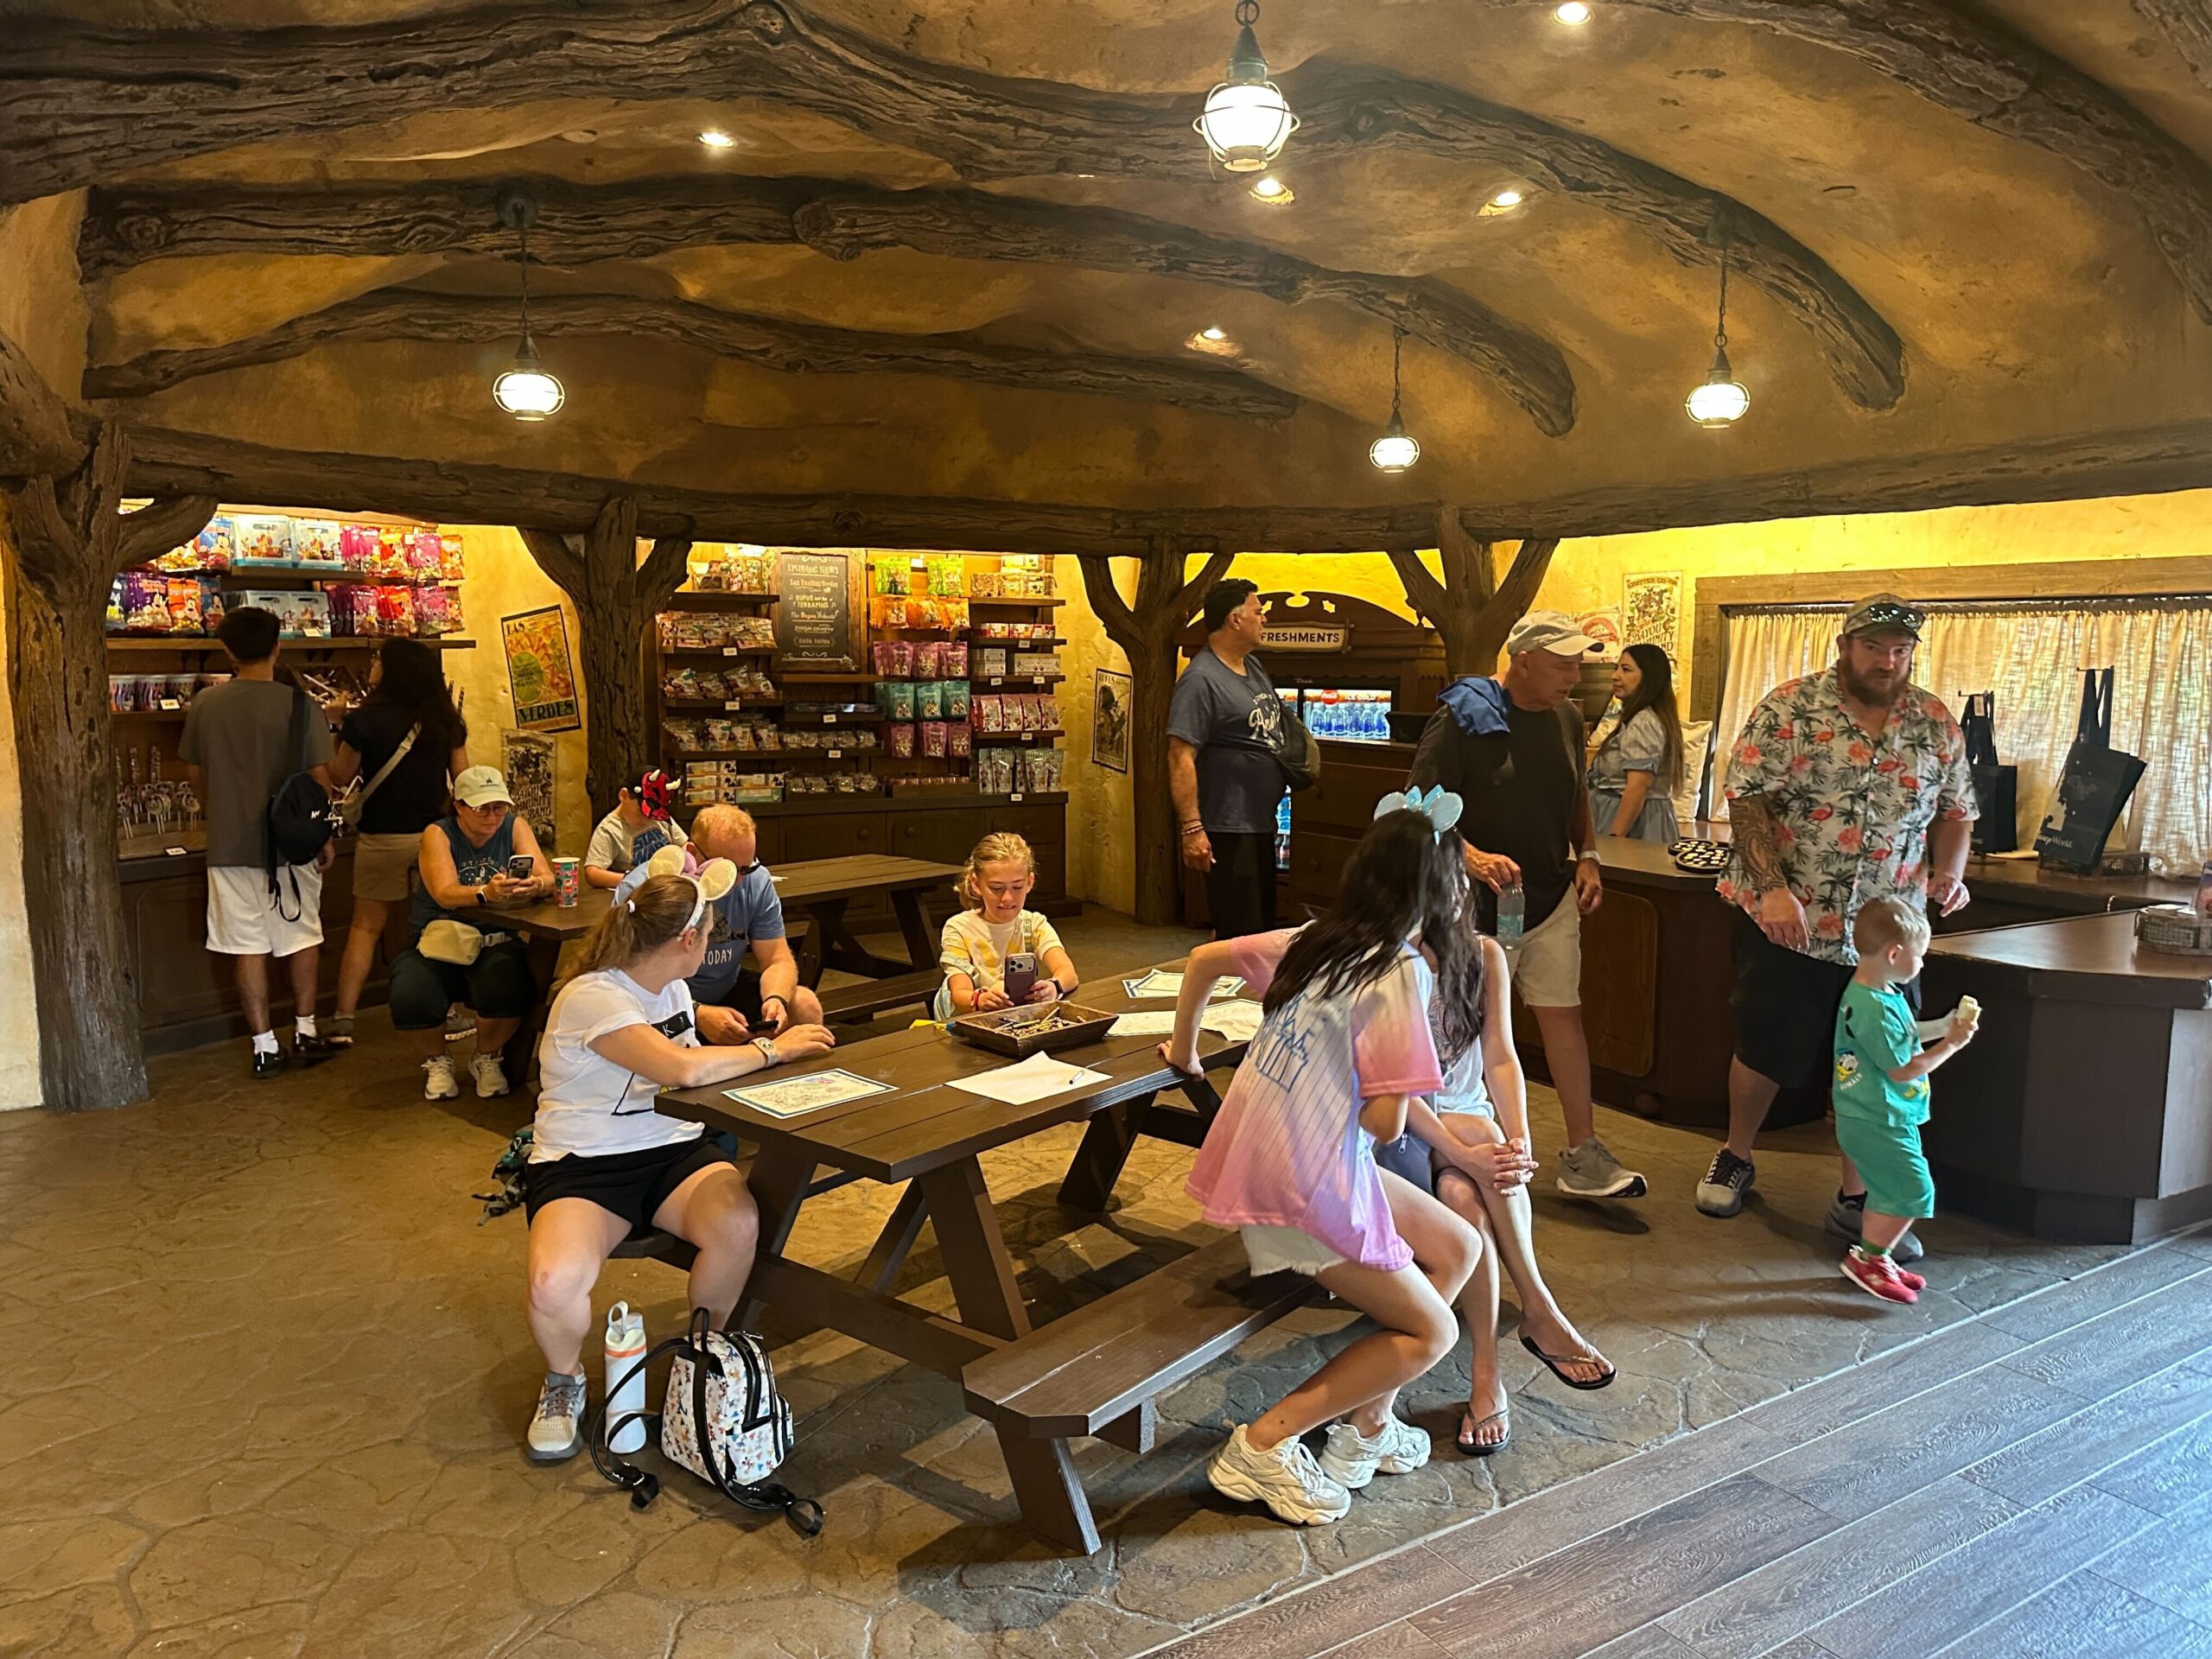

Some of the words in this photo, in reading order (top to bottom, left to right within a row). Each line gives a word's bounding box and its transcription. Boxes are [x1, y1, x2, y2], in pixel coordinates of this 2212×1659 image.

[506, 621, 525, 636] LAS
[1261, 632, 1339, 643] FRESHMENTS
[1632, 622, 1662, 645] BAYOU
[518, 698, 574, 723] VERDES
[511, 795, 551, 815] OMMUNITY
